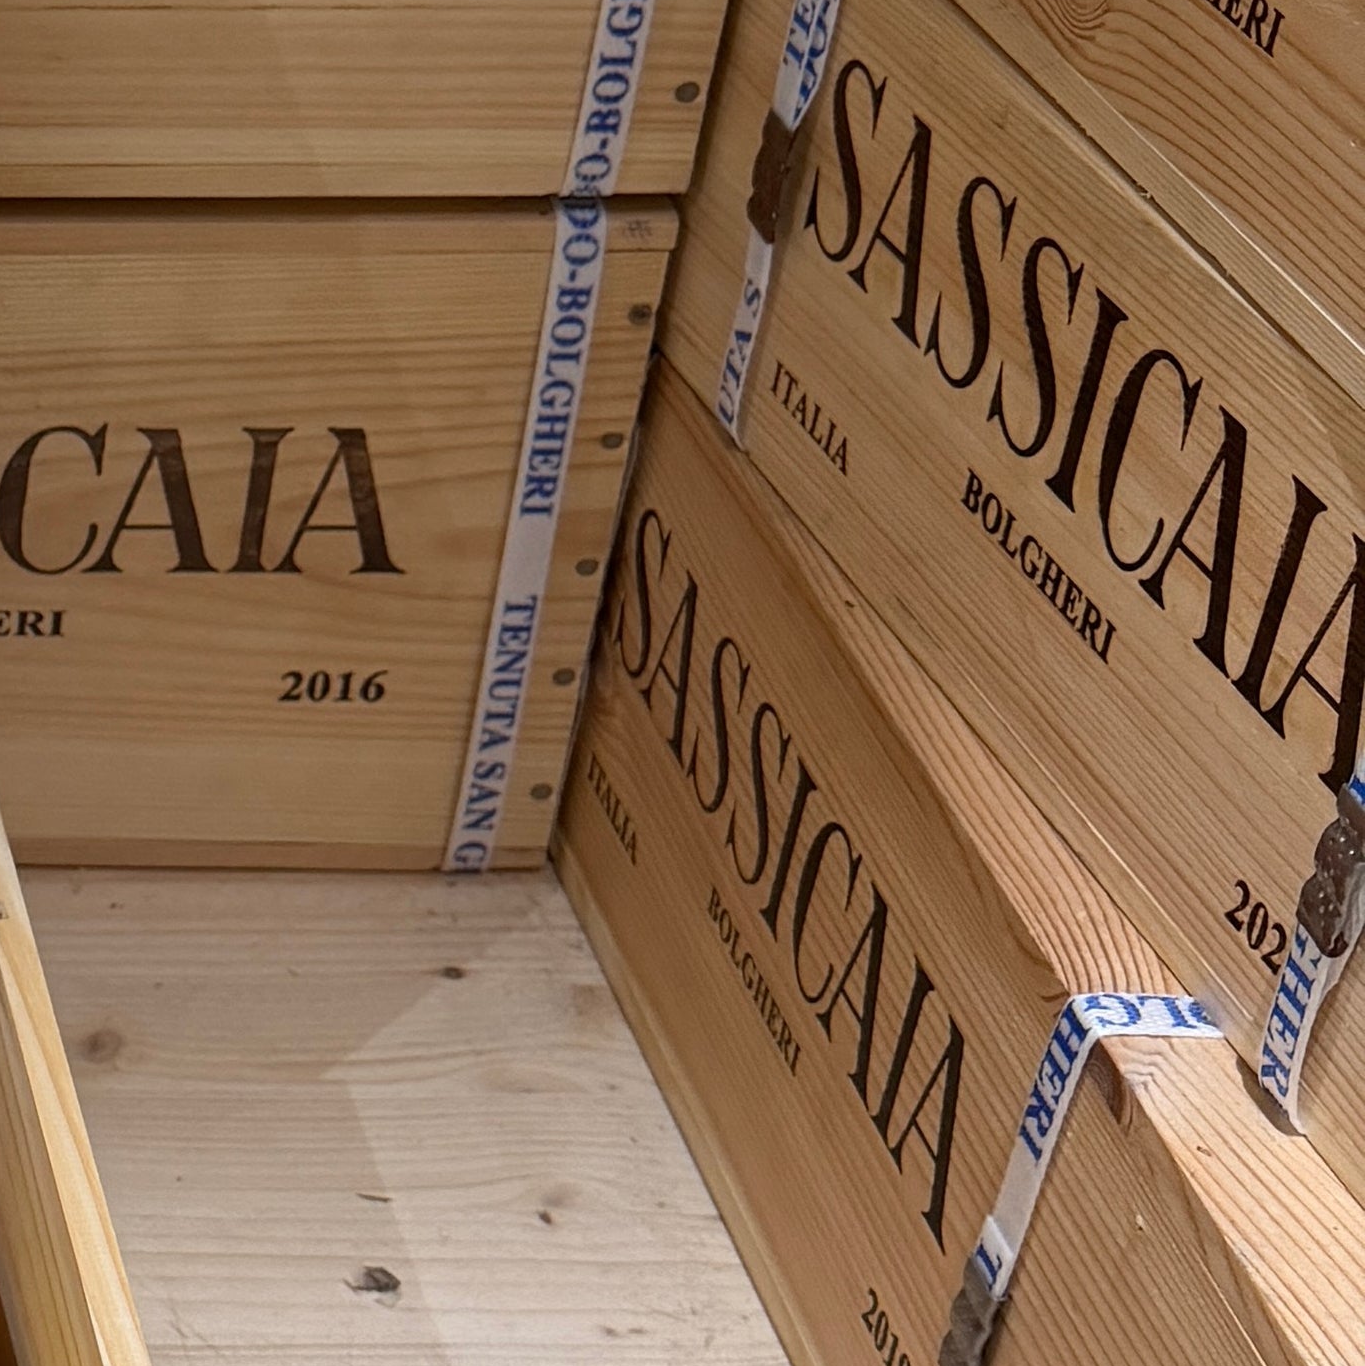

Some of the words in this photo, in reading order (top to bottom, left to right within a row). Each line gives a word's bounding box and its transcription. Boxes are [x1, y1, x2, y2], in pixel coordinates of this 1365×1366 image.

[771, 360, 850, 477] ITALIA
[961, 466, 1117, 665] BOLGHERI
[278, 668, 389, 704] 2016
[482, 593, 539, 752] TENUTA
[460, 759, 510, 836] SAN
[585, 751, 638, 867] ITALIA
[614, 508, 967, 1257] SASSICAIA
[1225, 878, 1289, 976] 202
[707, 885, 805, 1078] BOLGHERI
